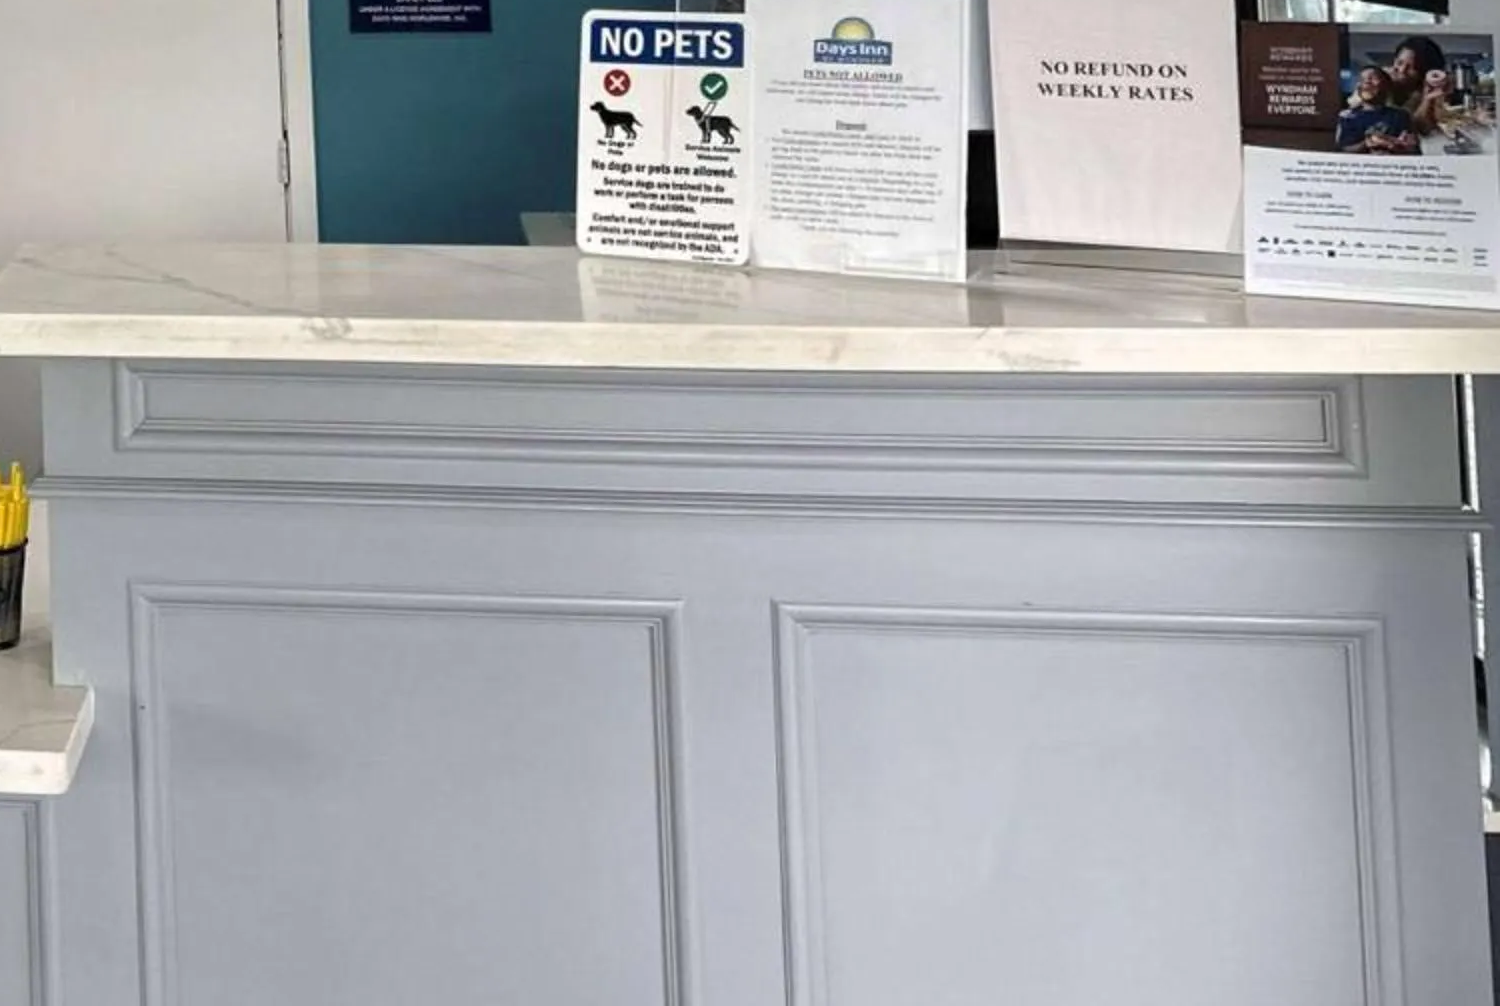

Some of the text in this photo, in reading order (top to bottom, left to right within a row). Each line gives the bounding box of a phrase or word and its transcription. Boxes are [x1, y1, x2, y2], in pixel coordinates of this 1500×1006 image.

[600, 27, 734, 60] NO PETS
[816, 42, 889, 56] Days Inn
[803, 69, 904, 84] PETS NOT ALLOWED
[1041, 60, 1188, 79] NO REFUND ON
[1038, 83, 1194, 102] WEEKLY RATES
[1265, 84, 1318, 94] WYNDHAM
[1269, 94, 1316, 104] REWARDS
[592, 158, 737, 179] No dogs or pets are allowed.
[603, 176, 725, 193] Service dogs are trained to do
[594, 188, 613, 197] work
[625, 190, 659, 201] perform
[660, 193, 666, 201] a
[667, 193, 685, 203] task
[687, 194, 699, 203] for
[700, 196, 734, 206] persons
[629, 202, 646, 211] with
[592, 213, 626, 223] Comfort
[659, 218, 701, 229] emotional
[702, 221, 735, 232] support
[588, 225, 739, 243] animals are not service animals, and
[601, 238, 725, 255] are not recognized by the ADA.
